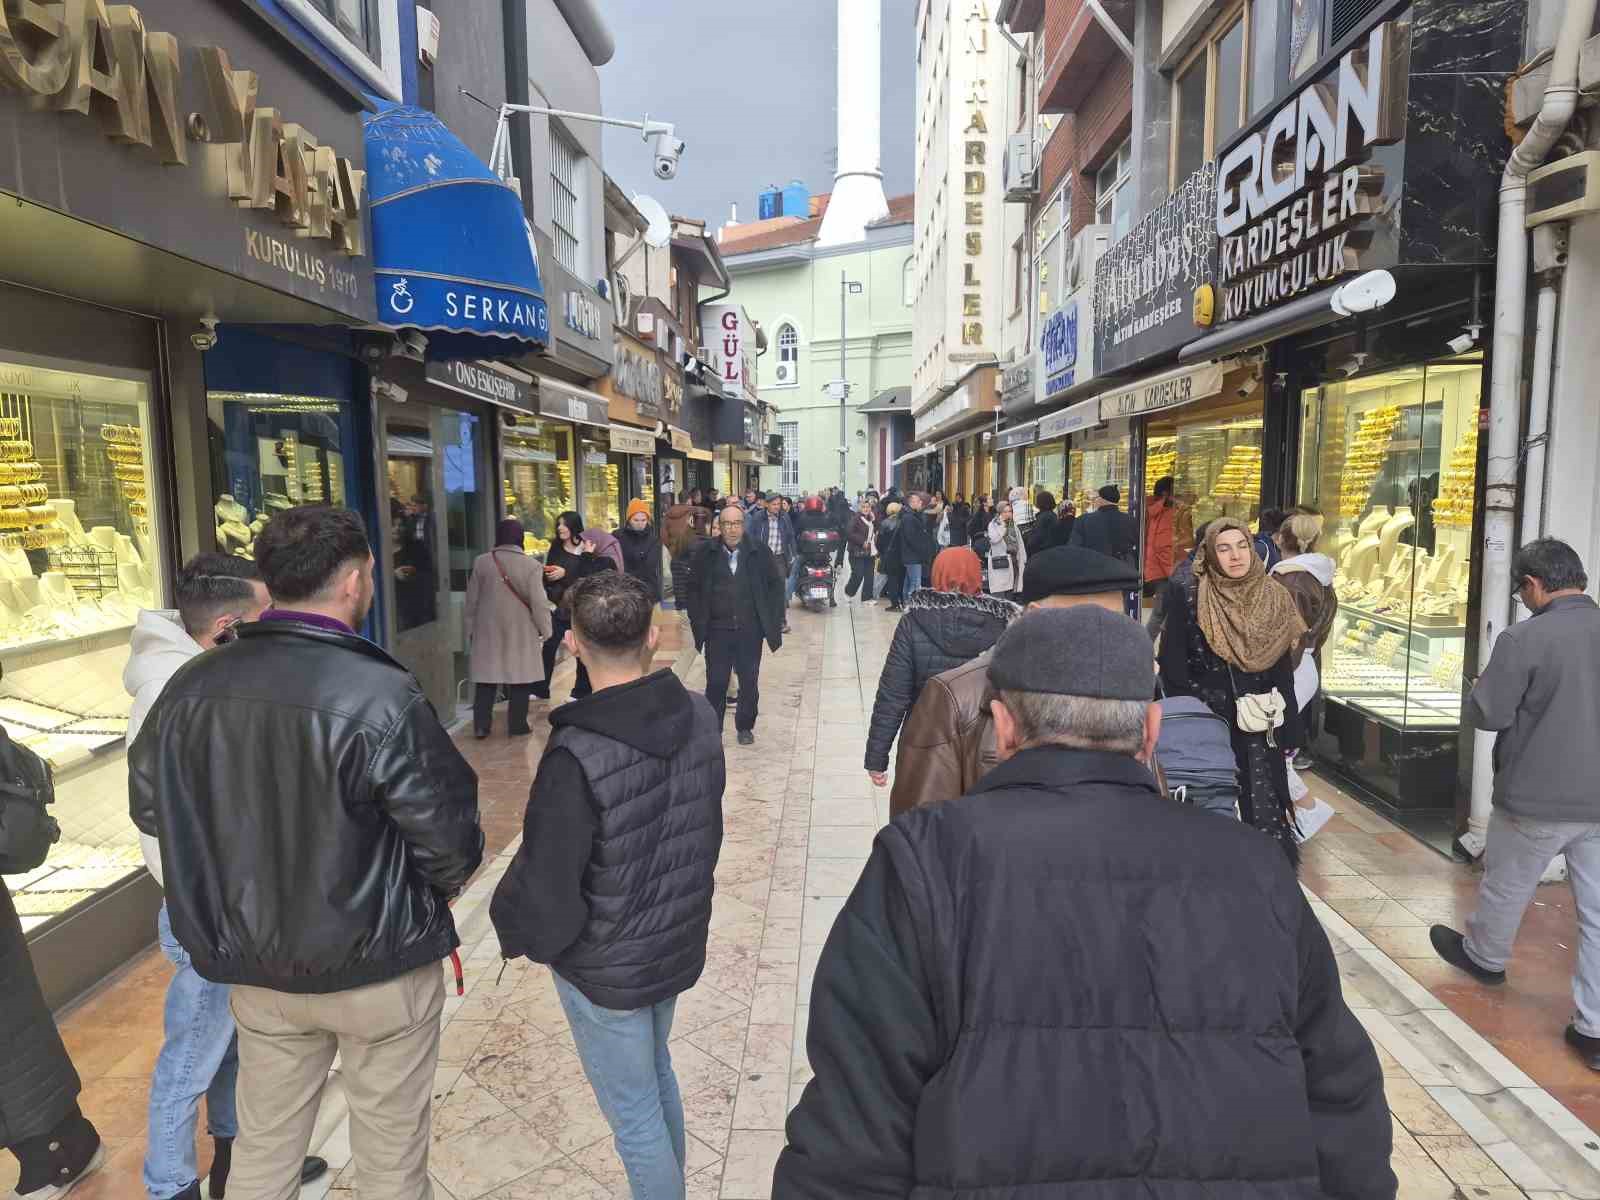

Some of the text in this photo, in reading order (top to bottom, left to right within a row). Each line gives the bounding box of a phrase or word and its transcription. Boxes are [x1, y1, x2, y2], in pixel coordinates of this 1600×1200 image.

[1217, 23, 1384, 237] ERCAN
[245, 228, 358, 299] KURULUŞ 1970
[1224, 231, 1349, 320] KUYUMCULUK
[721, 312, 739, 380] GÜL
